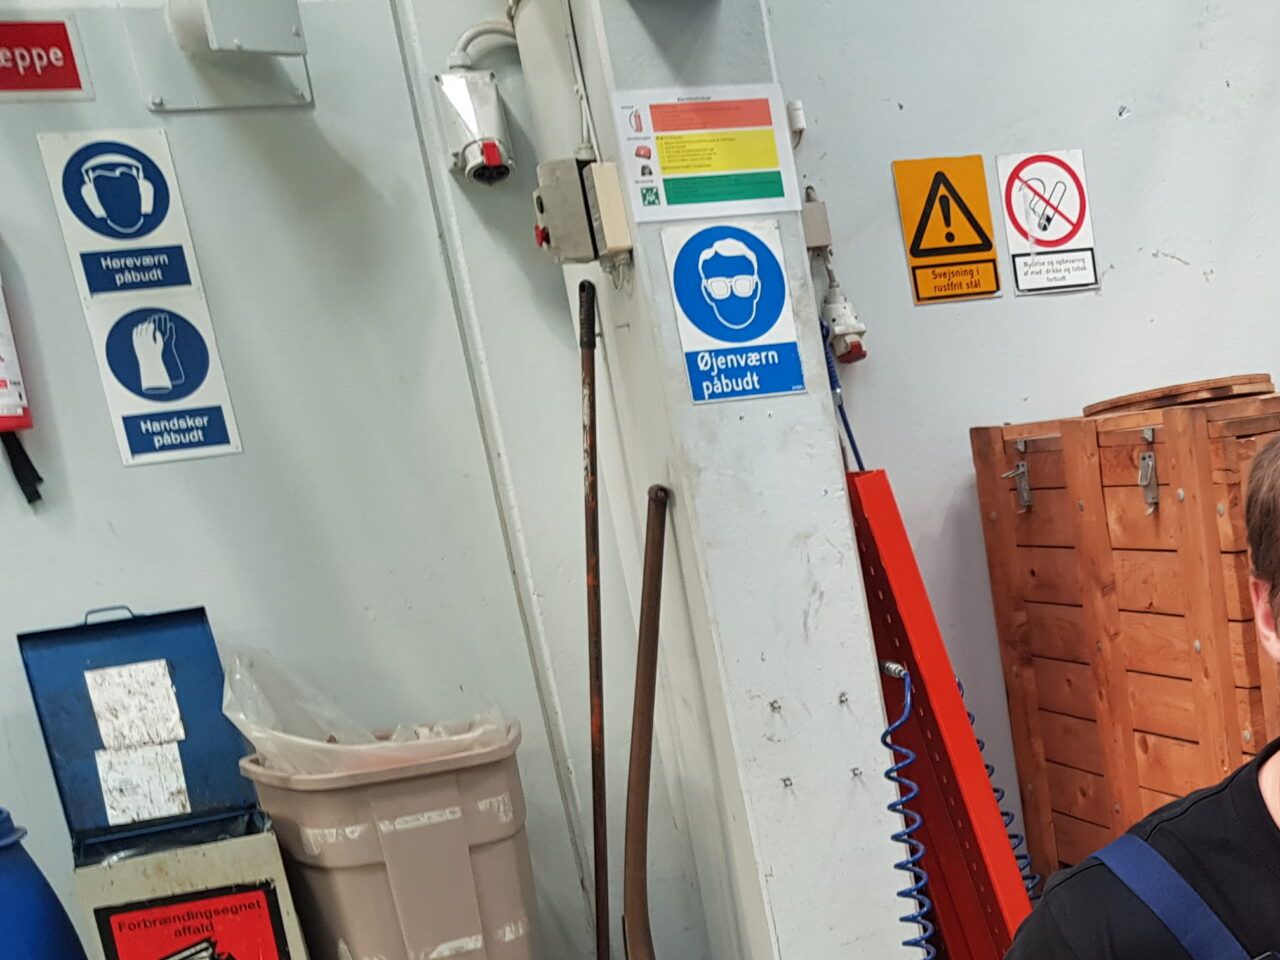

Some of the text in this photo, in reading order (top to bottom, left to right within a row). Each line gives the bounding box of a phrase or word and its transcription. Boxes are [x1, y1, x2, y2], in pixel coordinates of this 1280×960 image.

[101, 254, 168, 270] Høreværn
[115, 268, 163, 287] påbudt
[931, 268, 974, 281] Svejsning
[934, 279, 981, 292] rustfrit stål
[697, 350, 779, 376] Øjenværn
[702, 371, 760, 400] påbudt
[140, 415, 208, 434] Handsker
[153, 429, 205, 449] påbudt
[118, 900, 262, 933] Forbrændingsegnet
[174, 922, 215, 938] affald
